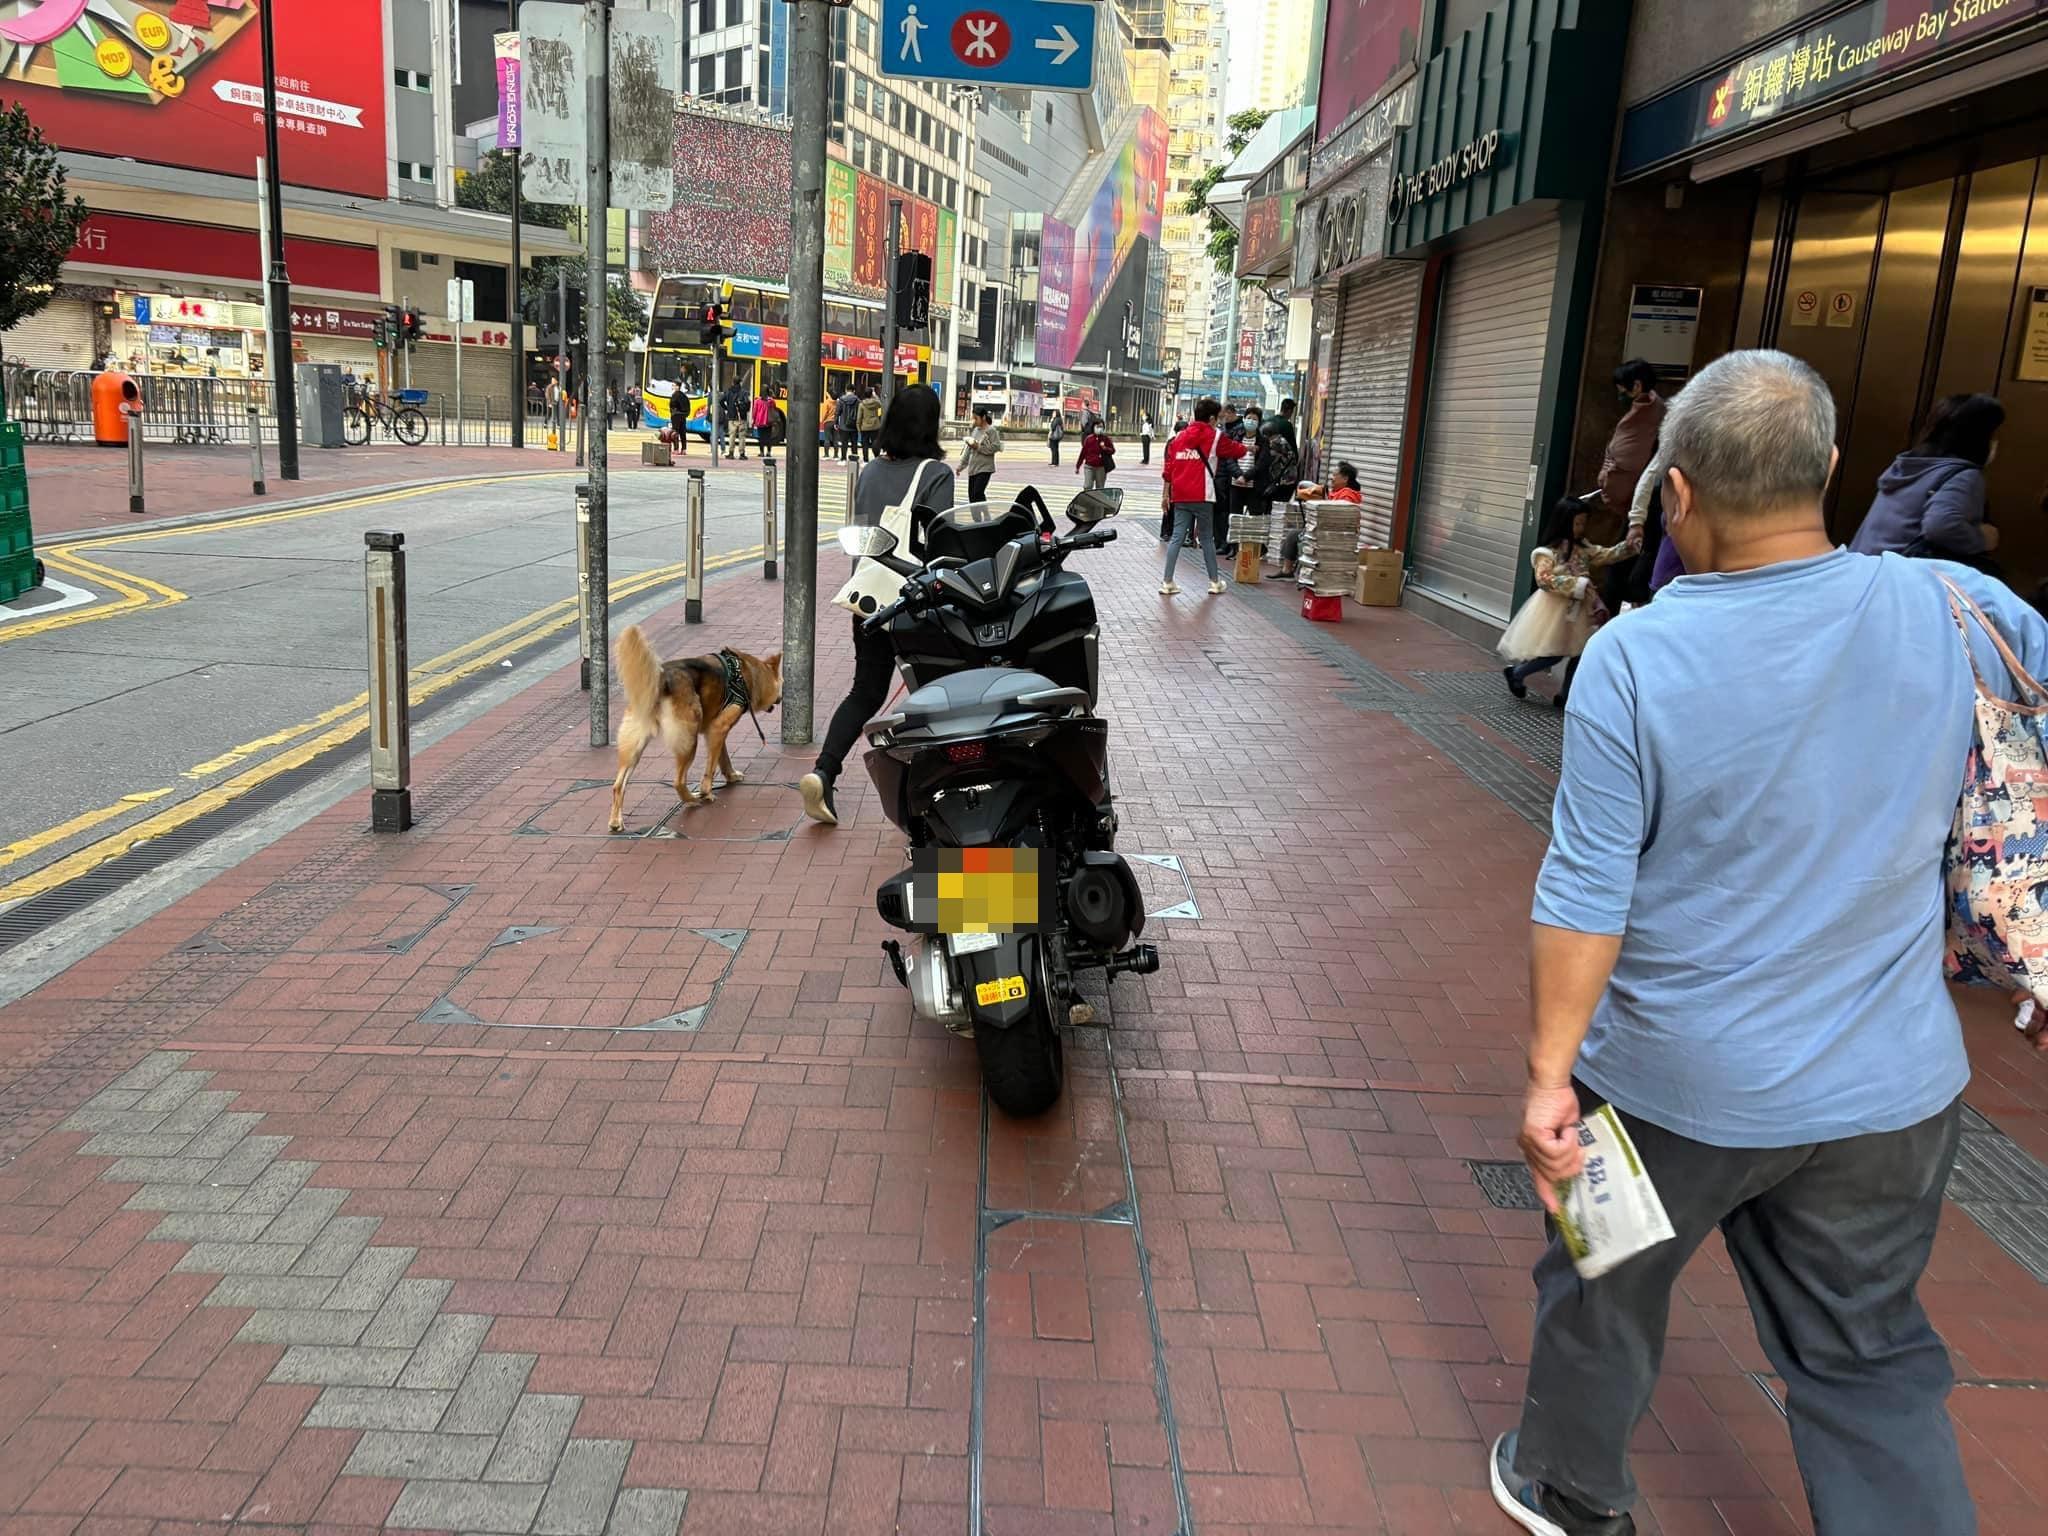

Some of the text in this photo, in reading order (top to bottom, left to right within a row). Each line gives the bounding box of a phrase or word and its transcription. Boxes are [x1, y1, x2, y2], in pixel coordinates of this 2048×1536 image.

[140, 26, 165, 38] EUR
[100, 51, 126, 64] MOP
[1741, 0, 2014, 112] 銅鑼灣站 Causeway Bay Statio
[1406, 129, 1498, 208] THE BODY SHOP
